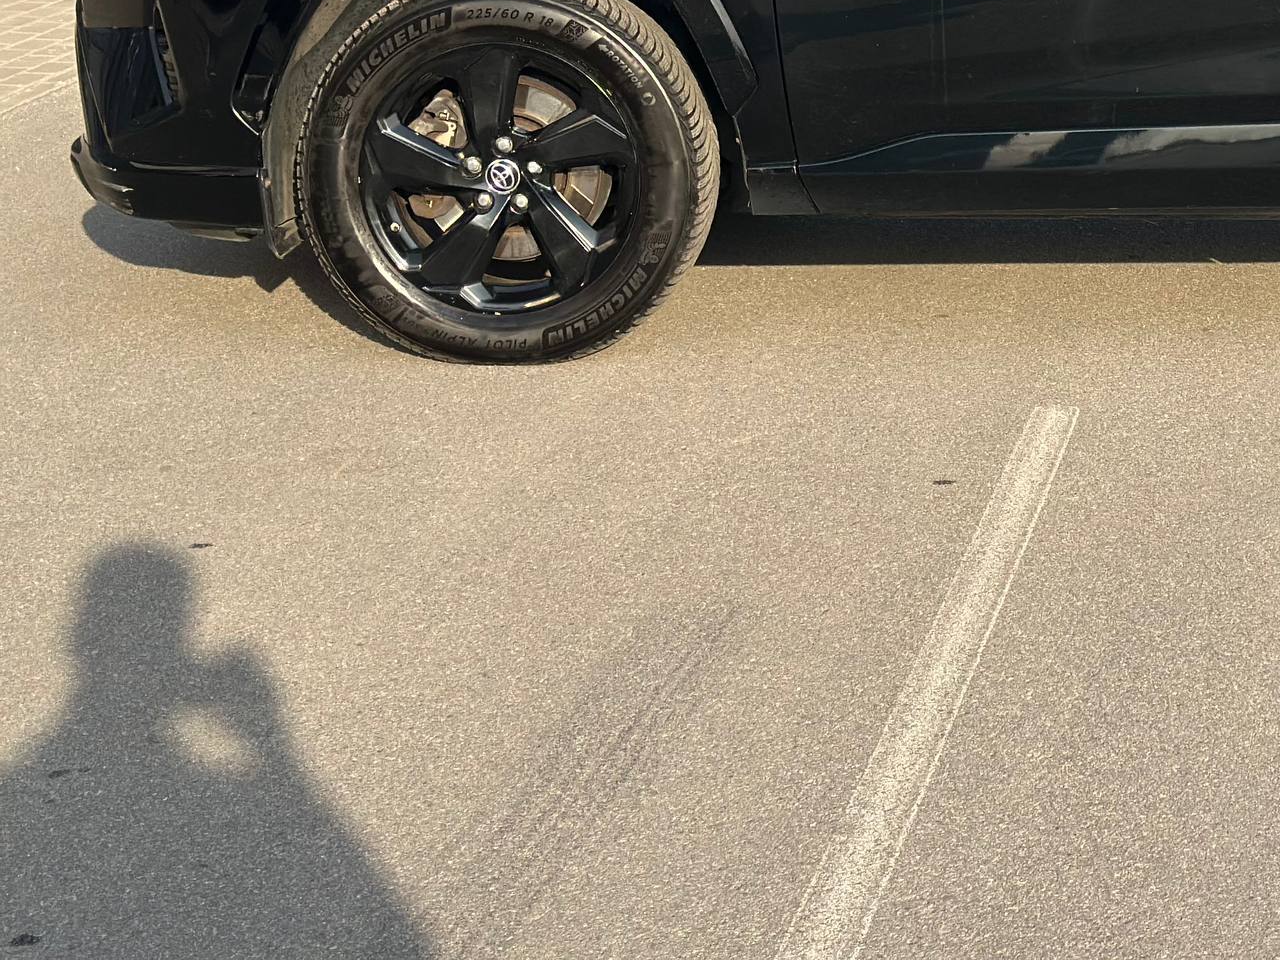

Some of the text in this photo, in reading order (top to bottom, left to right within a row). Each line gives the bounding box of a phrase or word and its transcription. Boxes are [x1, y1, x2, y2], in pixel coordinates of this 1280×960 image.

[466, 7, 555, 27] 225/60 R 18
[345, 11, 447, 94] MICHELIN
[606, 49, 643, 90] ROTATION
[547, 266, 648, 347] MICHELIN
[433, 329, 528, 351] PILOT ALPIN
